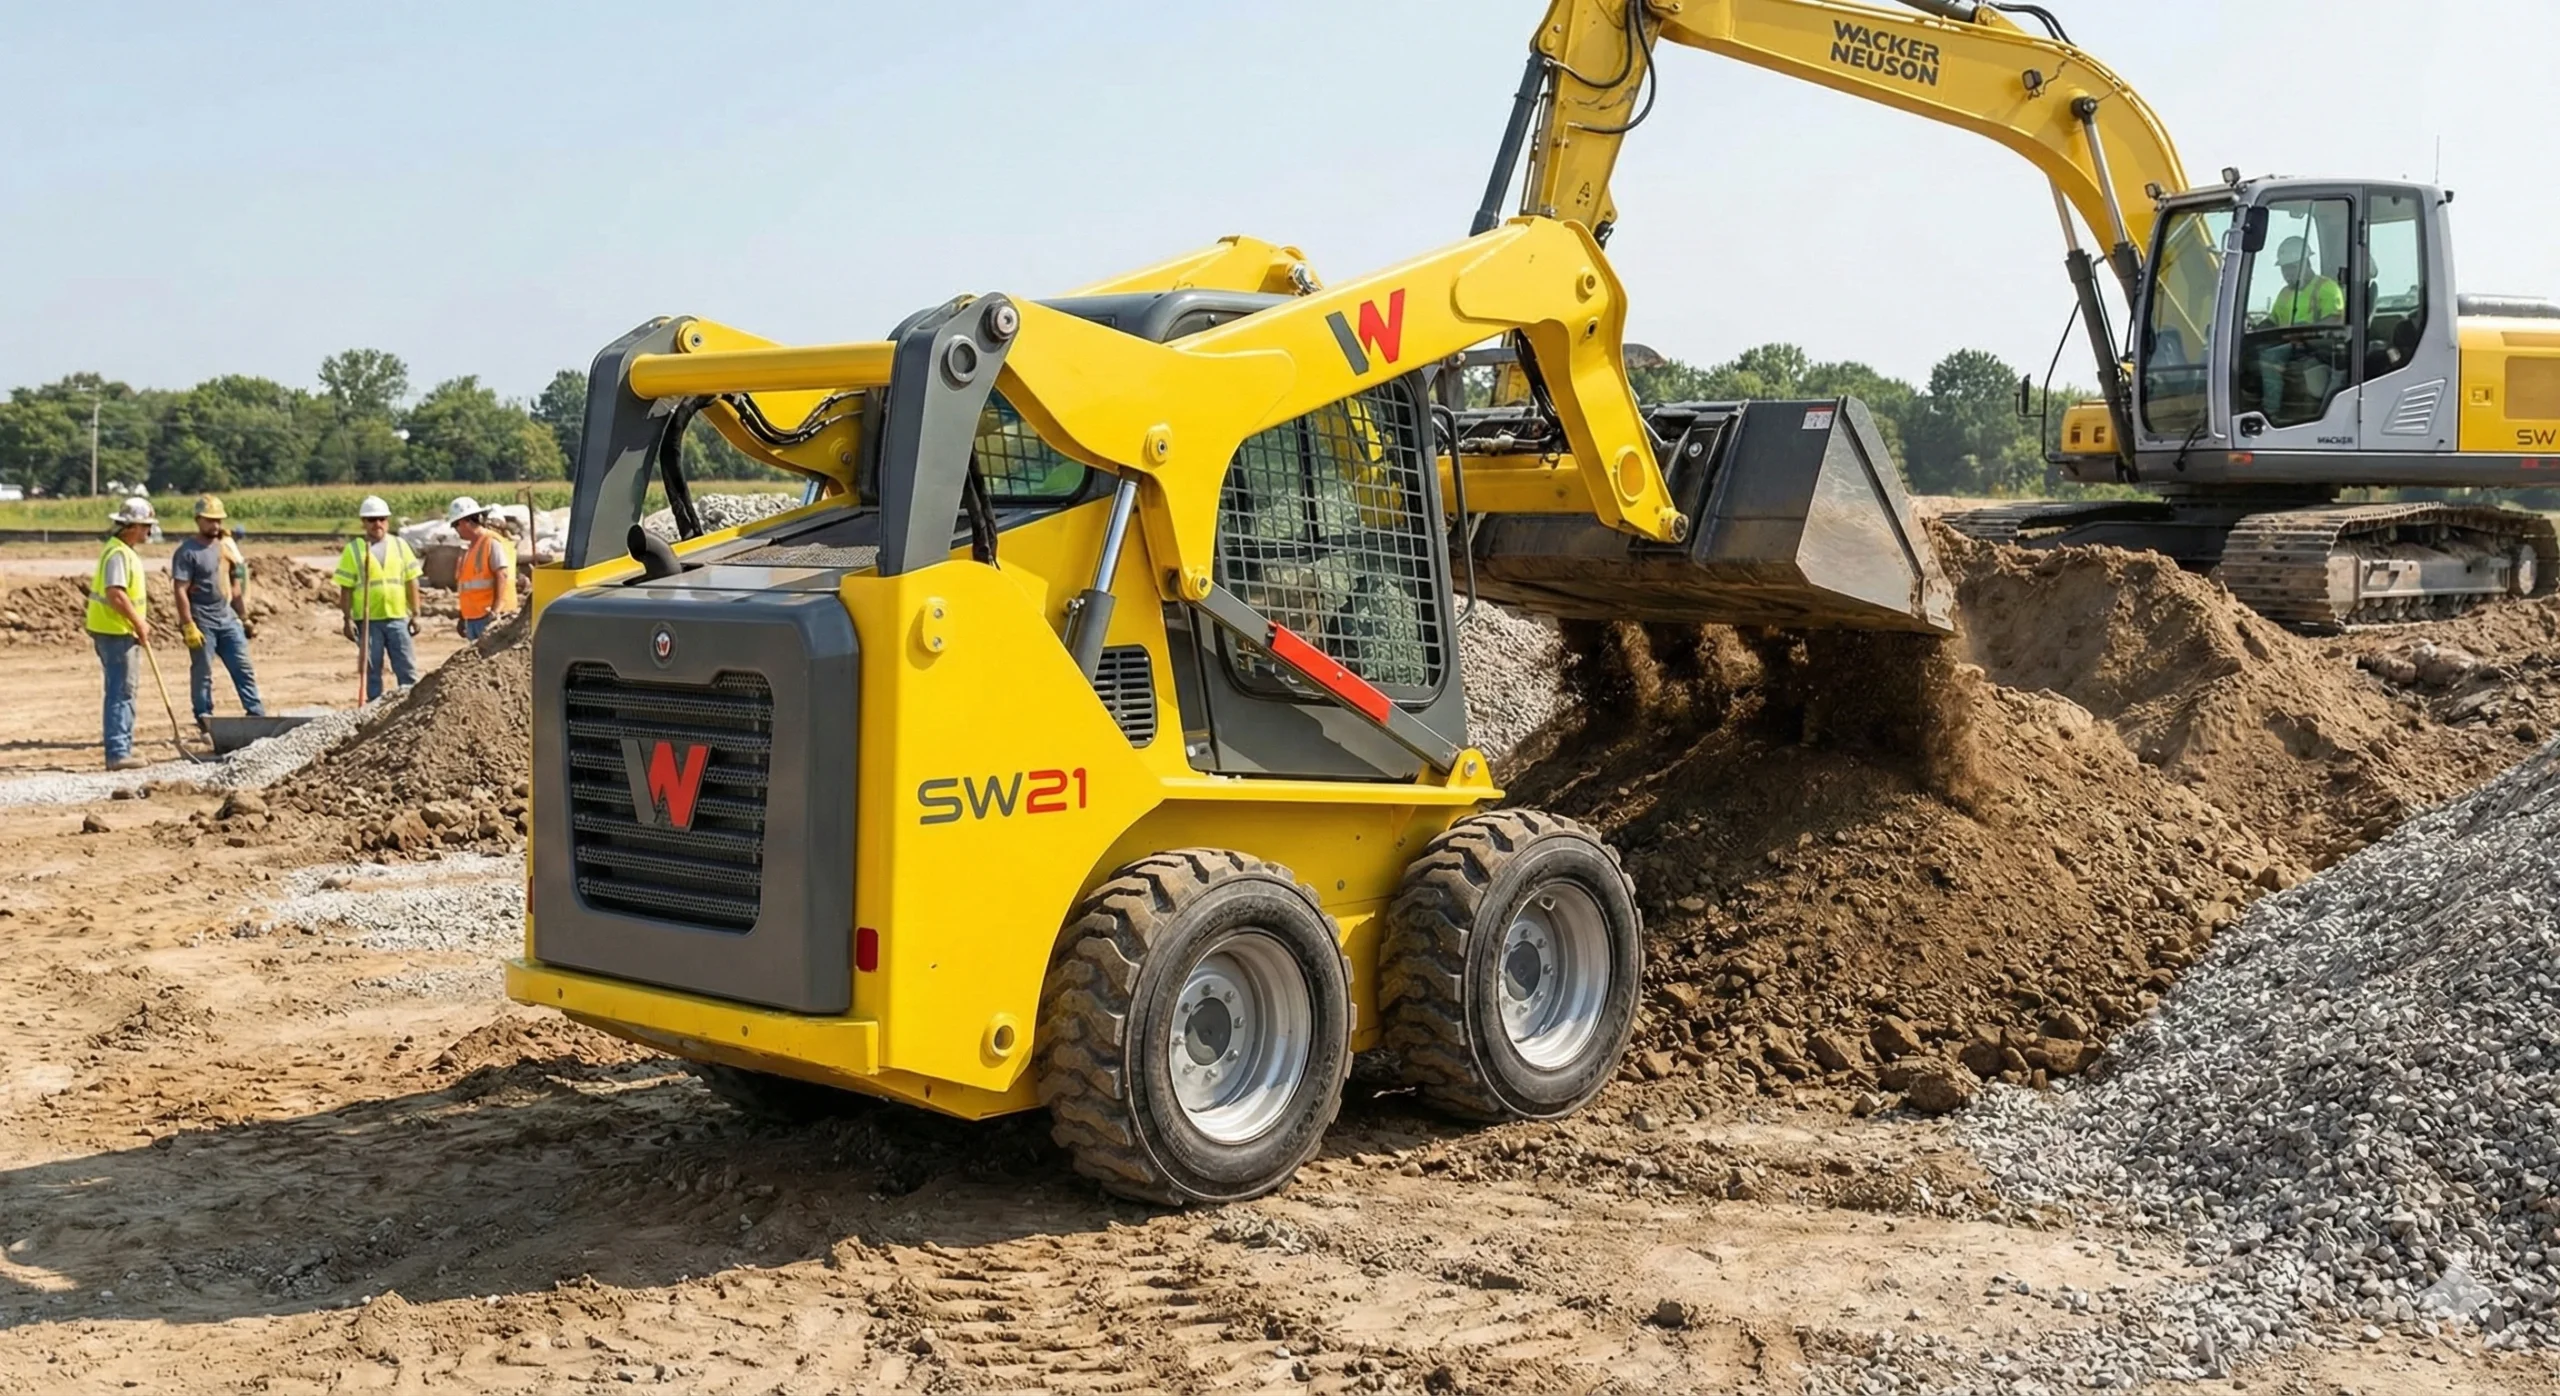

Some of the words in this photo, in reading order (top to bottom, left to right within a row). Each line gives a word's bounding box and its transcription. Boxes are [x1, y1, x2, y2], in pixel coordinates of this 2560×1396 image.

[1830, 42, 1939, 86] NEUSON
[1833, 20, 1940, 65] WACKER
[2516, 429, 2557, 446] SW
[917, 767, 1087, 825] SW21
